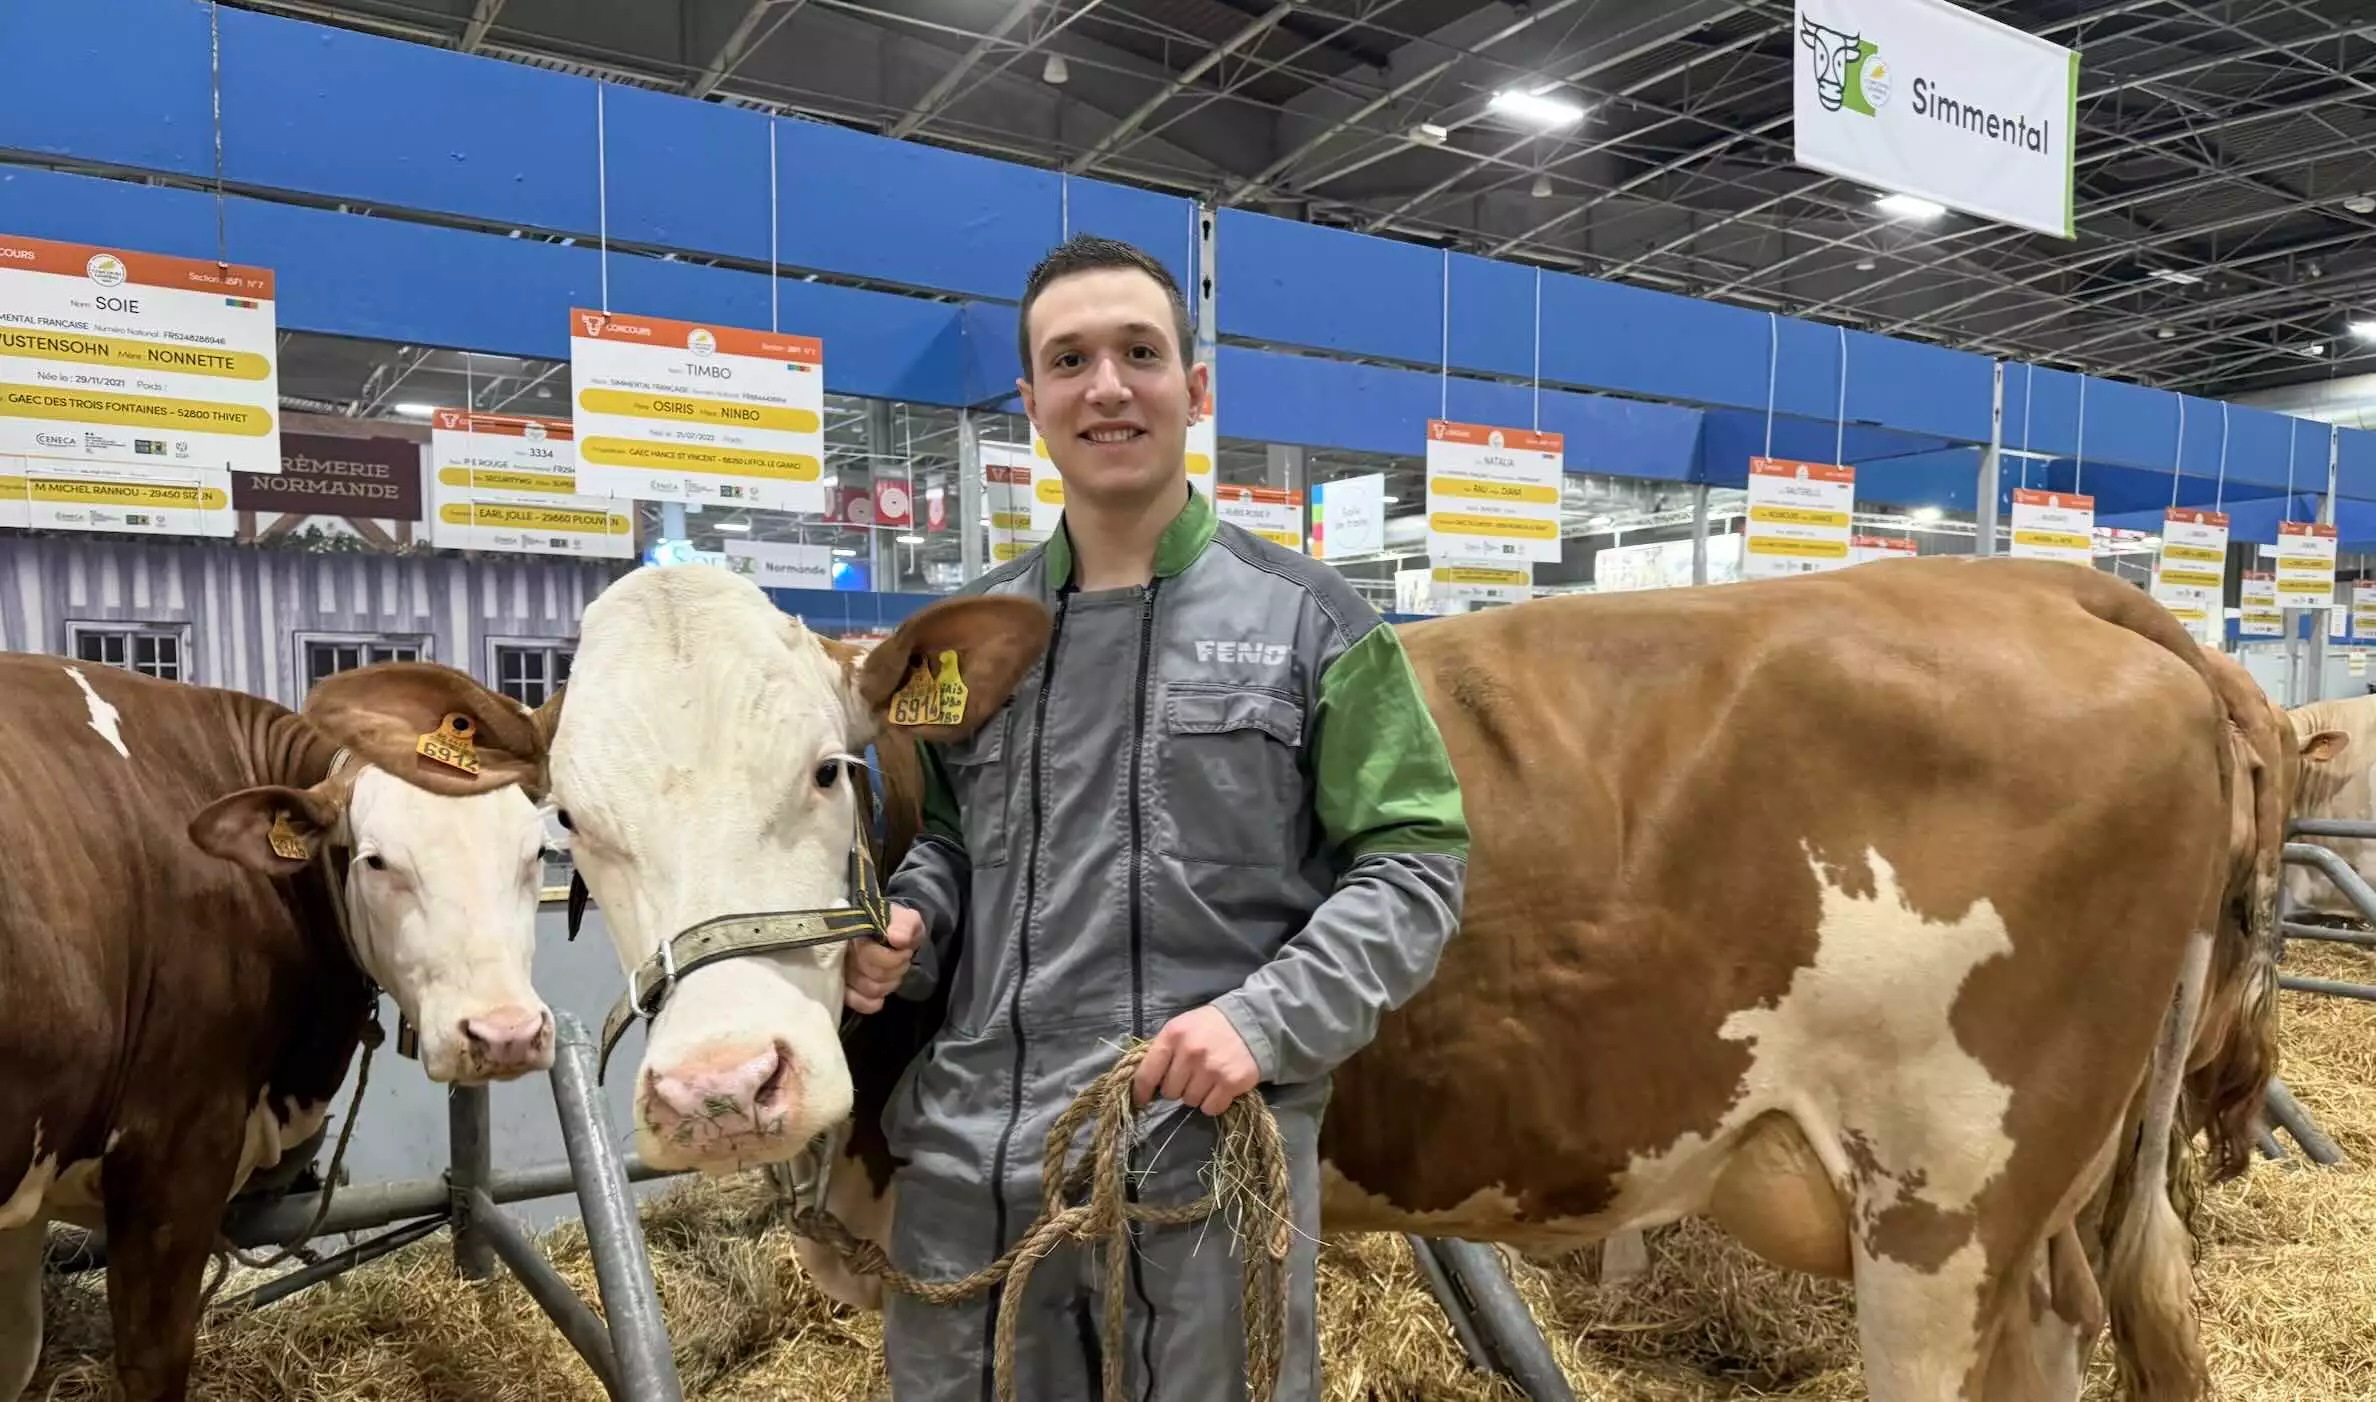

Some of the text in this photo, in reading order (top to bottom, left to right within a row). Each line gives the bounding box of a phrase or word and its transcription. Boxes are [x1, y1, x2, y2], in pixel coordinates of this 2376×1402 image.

[1912, 77, 2048, 155] Simmental
[95, 296, 141, 314] SOIE
[0, 332, 109, 357] USTENSOHN
[147, 348, 235, 370] NONNETTE
[686, 363, 732, 380] TIMBO
[8, 393, 42, 406] GAEC
[44, 396, 67, 408] DES
[68, 398, 104, 411] TROIS
[105, 401, 167, 417] FONTAINES
[177, 407, 210, 420] 52800
[212, 410, 249, 424] THIVET
[652, 400, 696, 415] OSIRIS
[720, 407, 761, 421] NINBO
[38, 434, 77, 446] CENECA
[528, 447, 554, 458] 3334
[34, 483, 46, 492] M
[48, 484, 91, 496] MICHEL
[92, 486, 139, 498] RANNOU
[149, 490, 181, 500] 29450
[250, 476, 400, 500] NORMANDE
[479, 508, 502, 519] EARL
[764, 561, 827, 577] Normande
[1194, 640, 1292, 666] FEND
